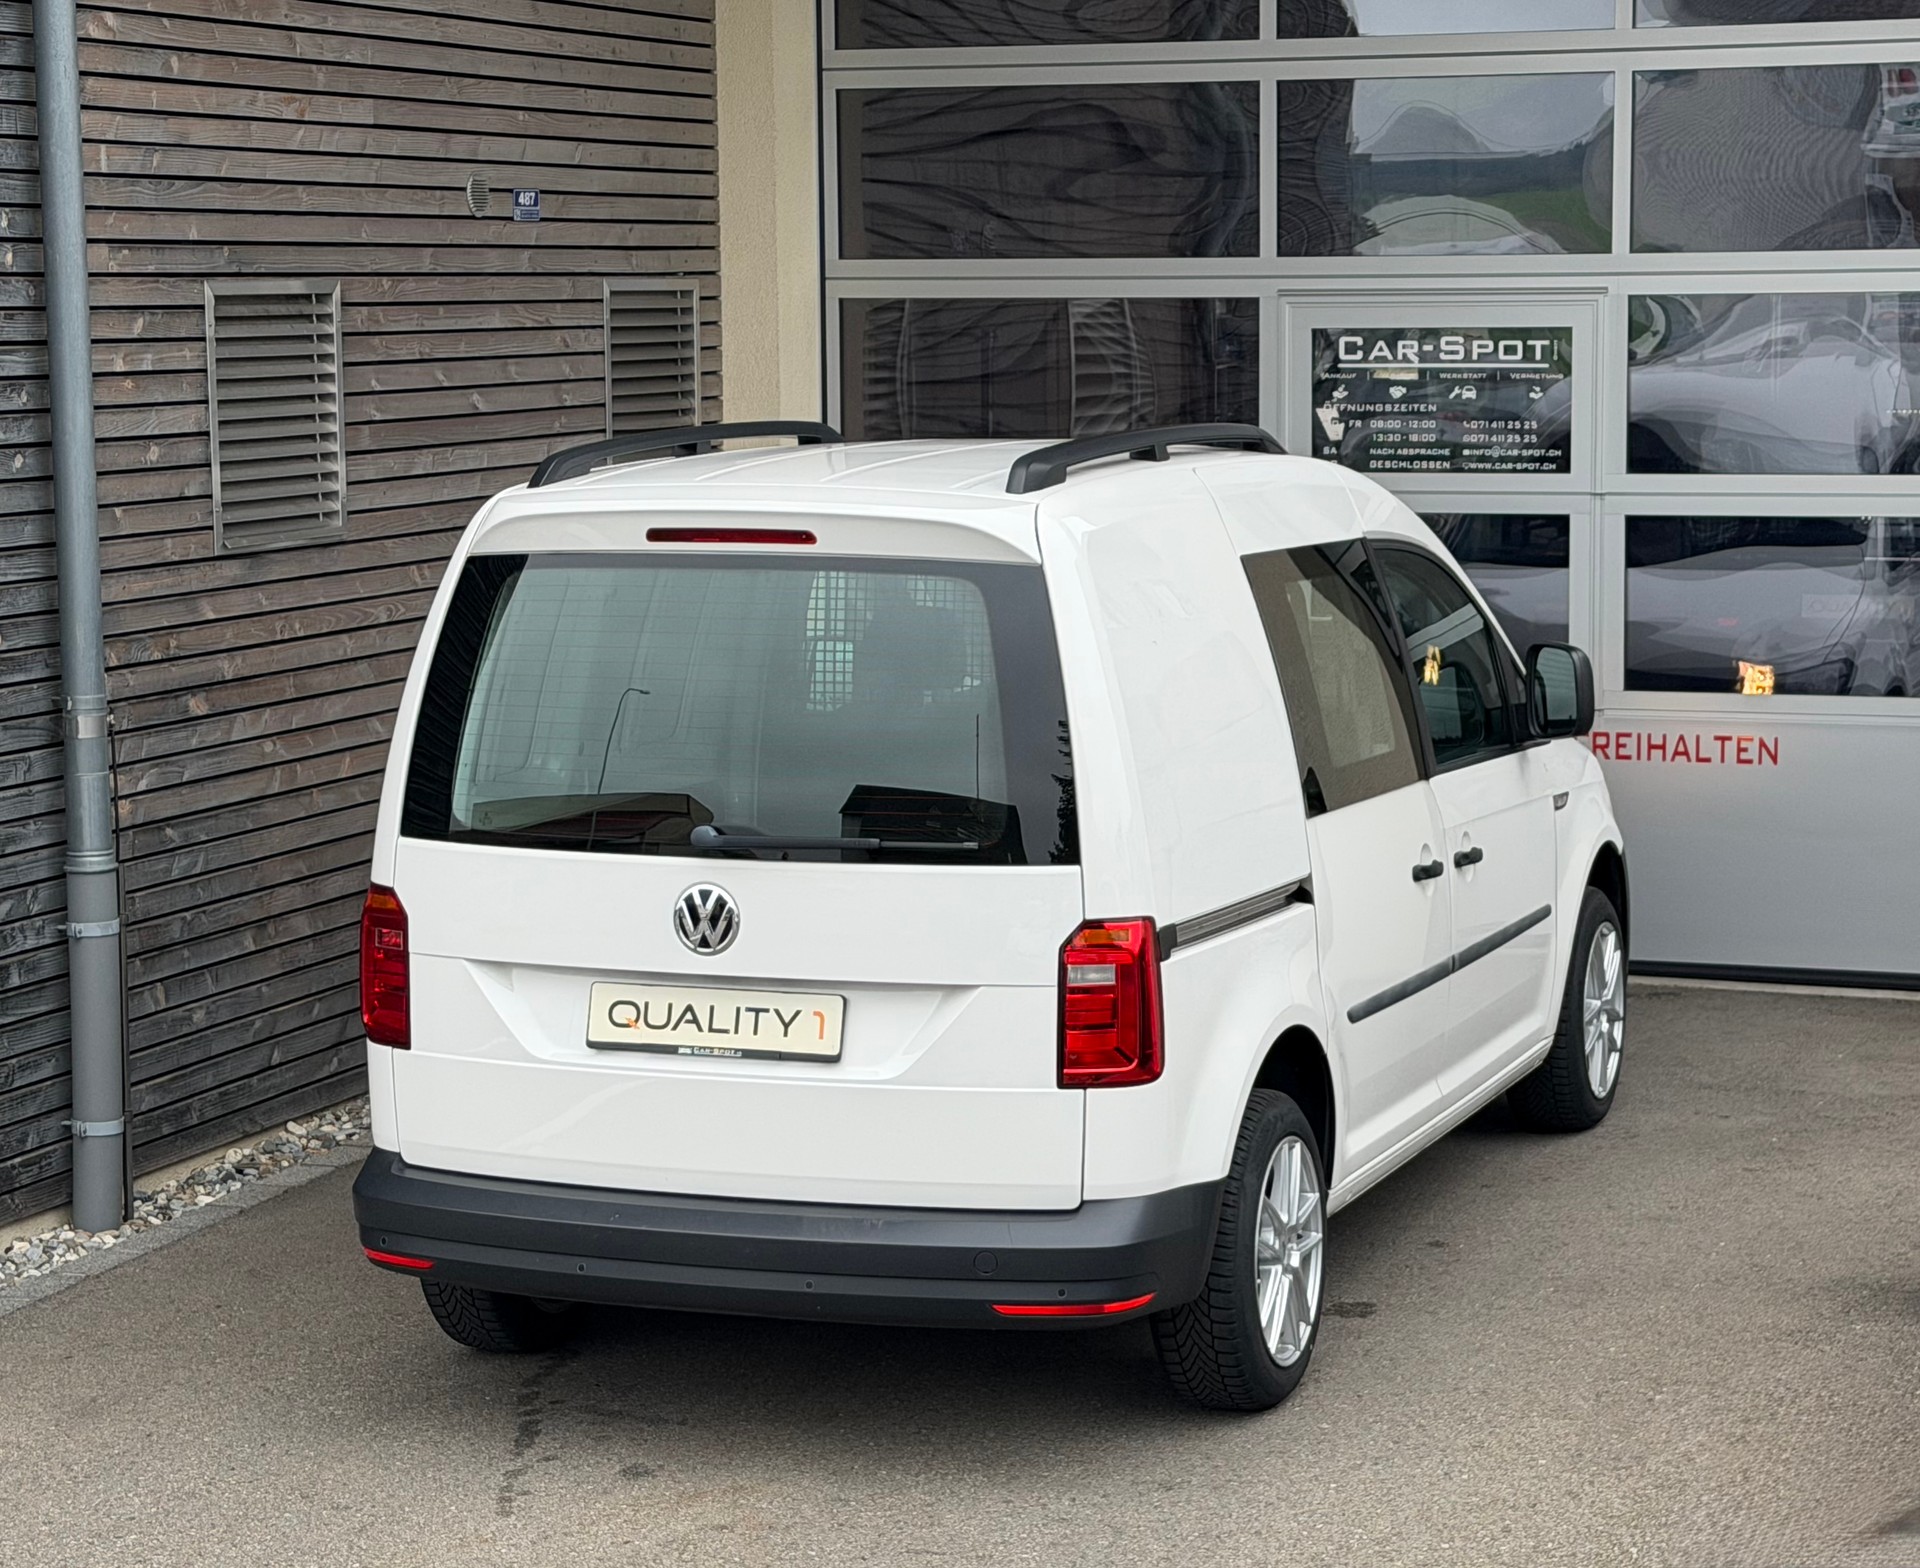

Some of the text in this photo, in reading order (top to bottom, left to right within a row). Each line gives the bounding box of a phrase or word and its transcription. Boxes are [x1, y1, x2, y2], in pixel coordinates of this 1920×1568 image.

[518, 192, 536, 206] 487
[1338, 336, 1550, 361] CAR-SPOT
[1348, 420, 1362, 428] FR
[1323, 446, 1338, 455] SA
[1369, 460, 1450, 469] GESCHLOSSEN
[1585, 731, 1779, 766] REIHALTEN
[608, 1000, 803, 1038] QUALITY
